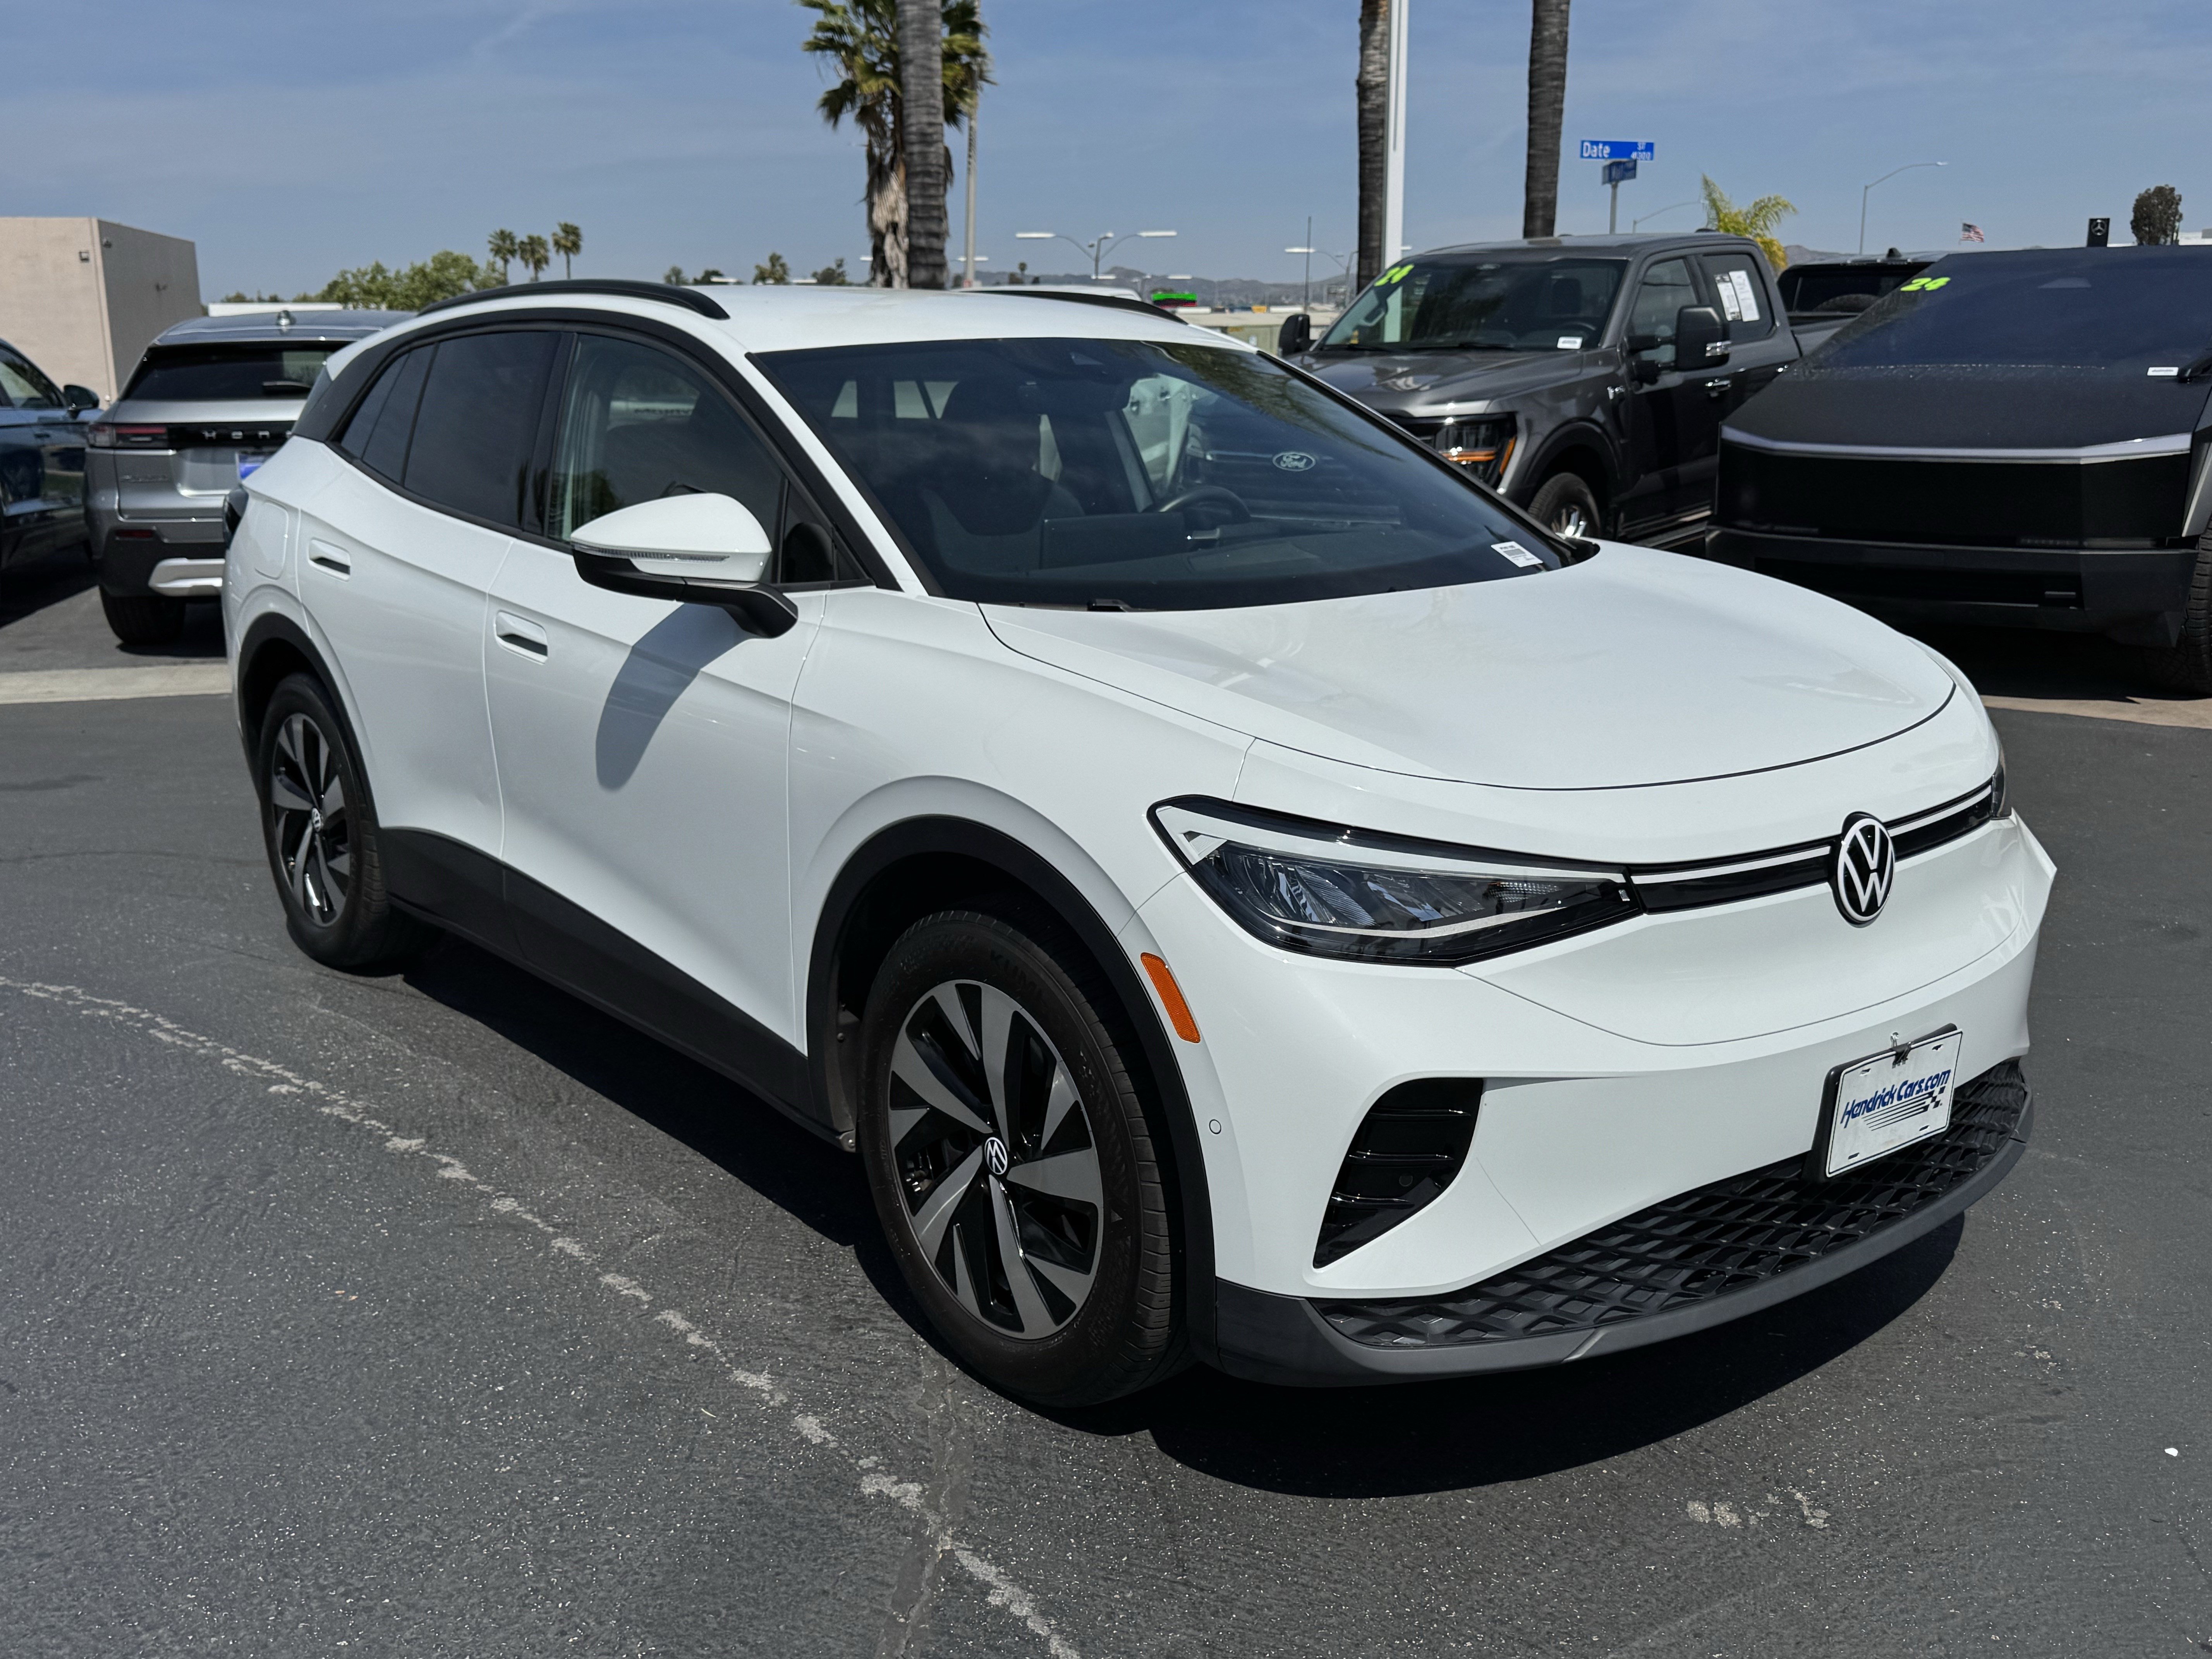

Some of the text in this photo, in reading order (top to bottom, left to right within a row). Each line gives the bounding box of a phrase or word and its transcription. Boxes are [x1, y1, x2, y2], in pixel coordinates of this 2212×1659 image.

[1582, 142, 1611, 158] Date
[1900, 277, 1951, 291] 24
[1280, 454, 1307, 468] Ford
